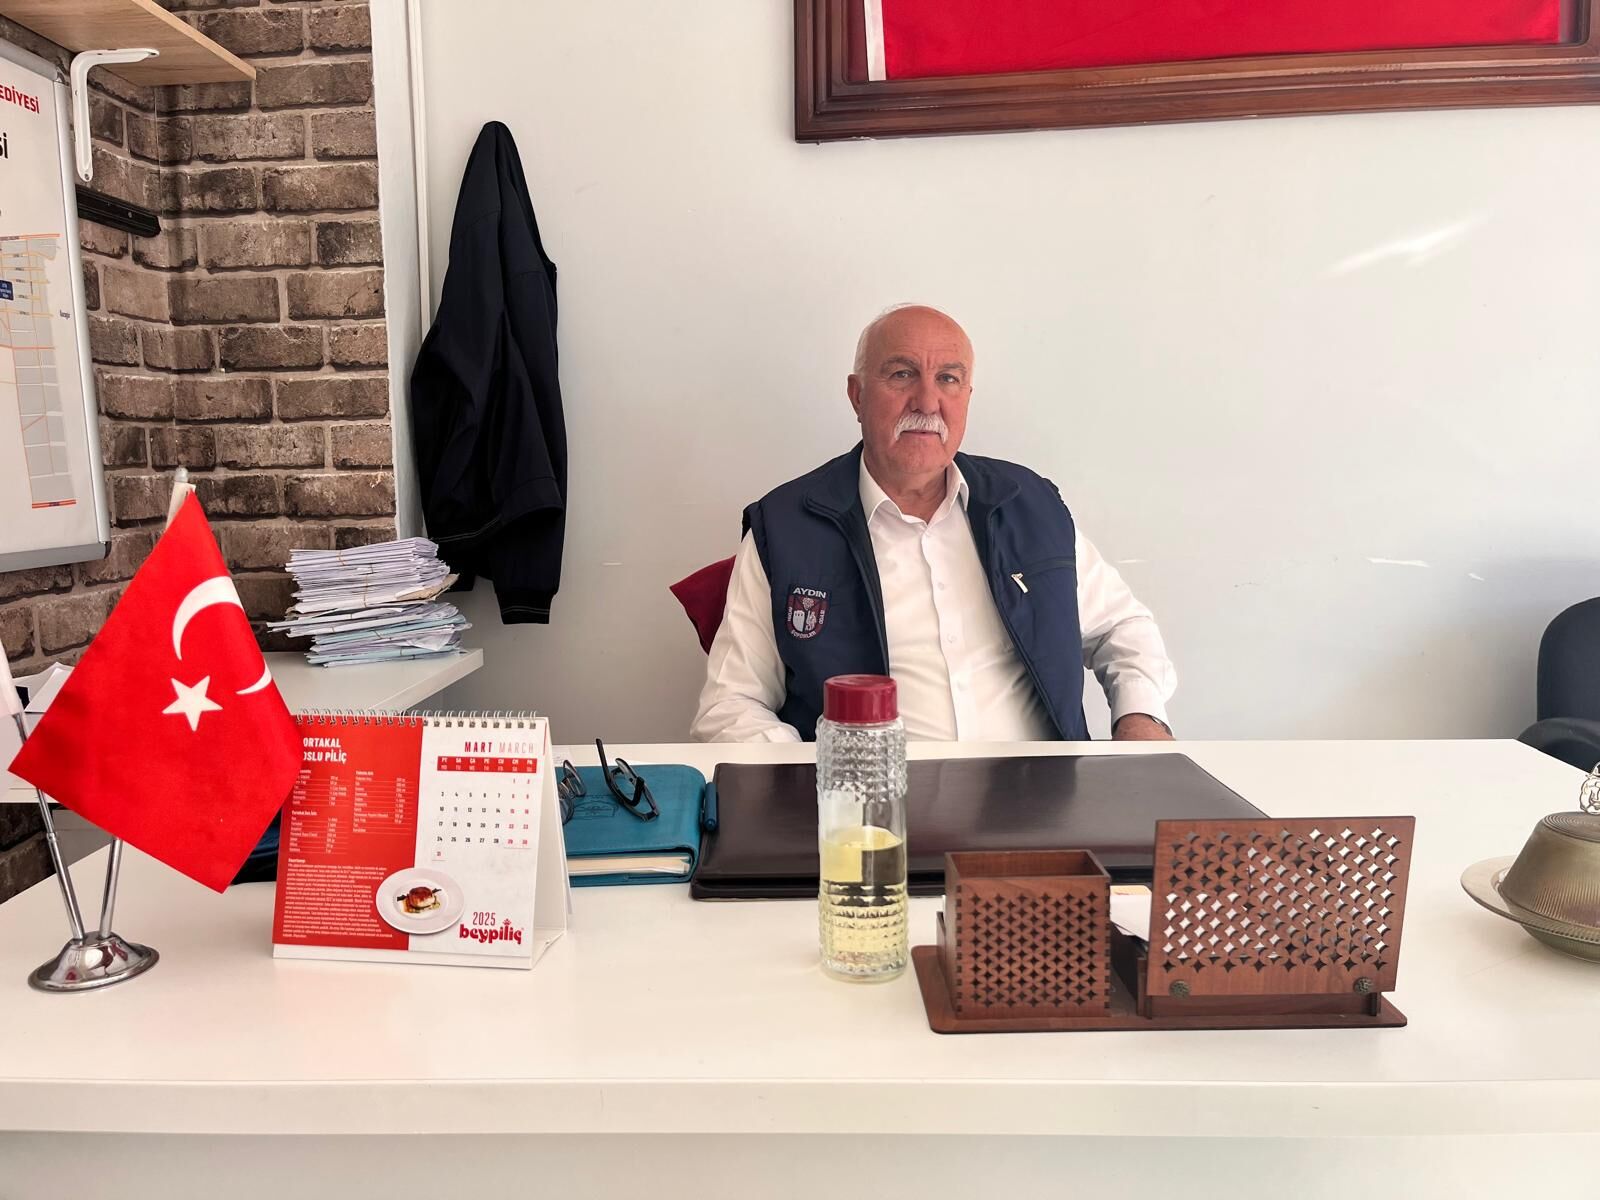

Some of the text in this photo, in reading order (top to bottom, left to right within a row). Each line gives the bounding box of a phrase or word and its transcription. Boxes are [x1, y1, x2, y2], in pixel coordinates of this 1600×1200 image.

[793, 587, 827, 599] AYDIN
[464, 741, 534, 753] MART MARCH
[325, 748, 347, 765] PİLİÇ
[472, 911, 496, 926] 2025
